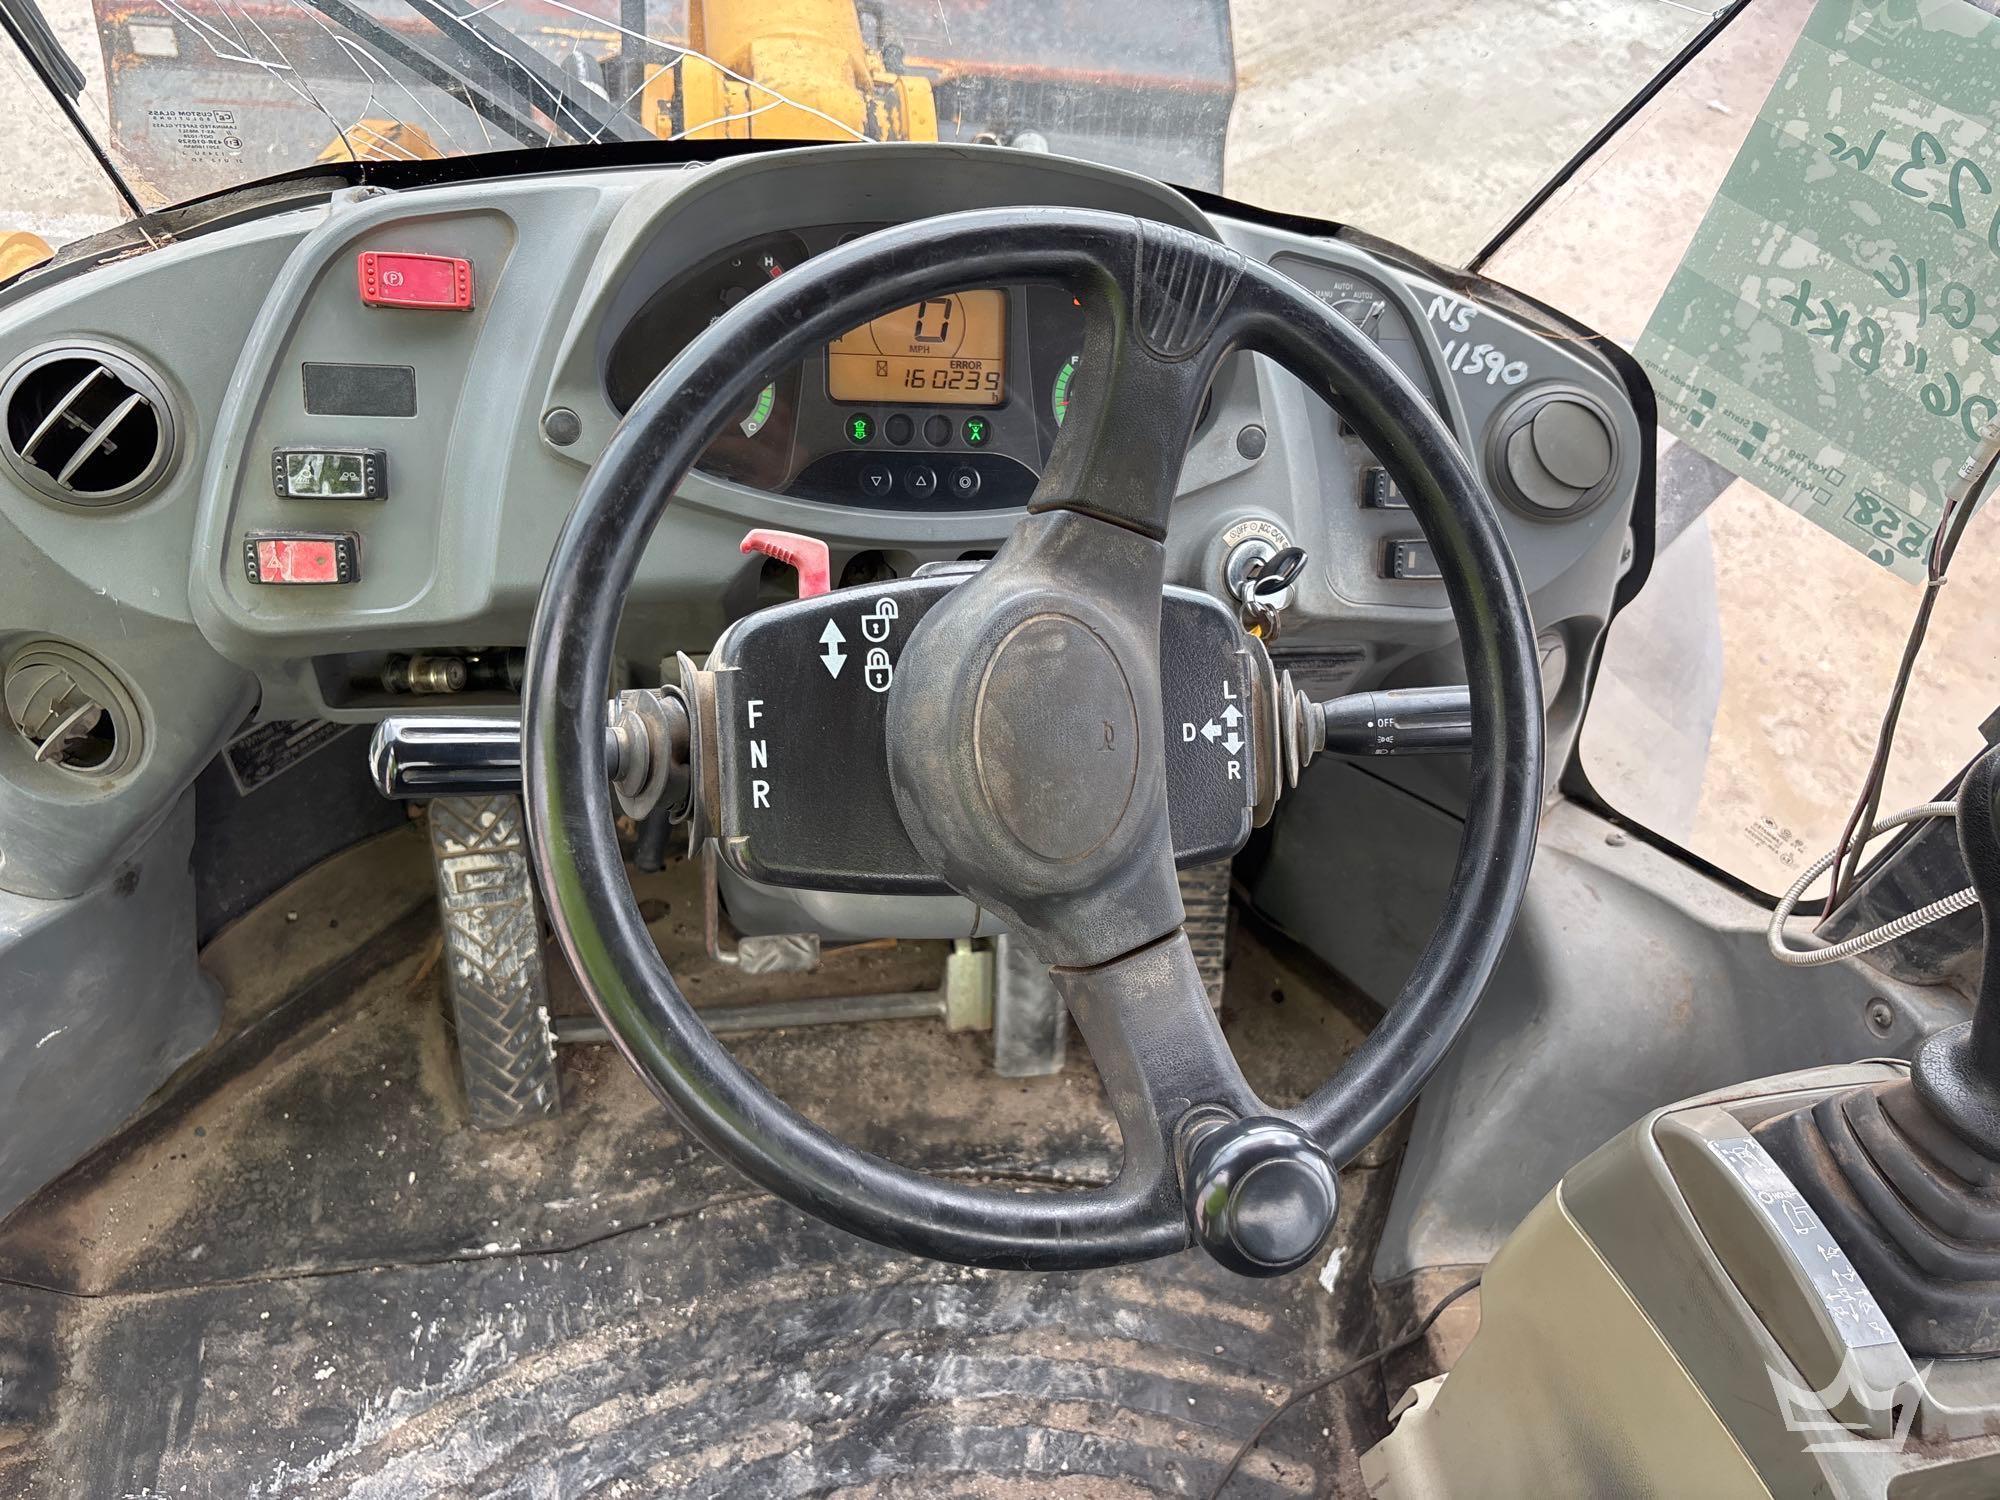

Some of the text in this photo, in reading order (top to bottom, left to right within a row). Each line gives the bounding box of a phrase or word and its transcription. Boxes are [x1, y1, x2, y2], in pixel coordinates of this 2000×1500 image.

[1333, 282, 1354, 290] AUTO1
[1353, 291, 1373, 299] AUTO2
[1427, 295, 1478, 333] NS
[908, 345, 930, 354] MPH
[950, 360, 982, 370] ERROR
[1223, 680, 1237, 700] L
[747, 699, 764, 729] F
[1377, 718, 1394, 728] OFF
[1182, 722, 1197, 742] D
[750, 739, 768, 769] N
[1227, 760, 1242, 780] R
[752, 779, 771, 809] R
